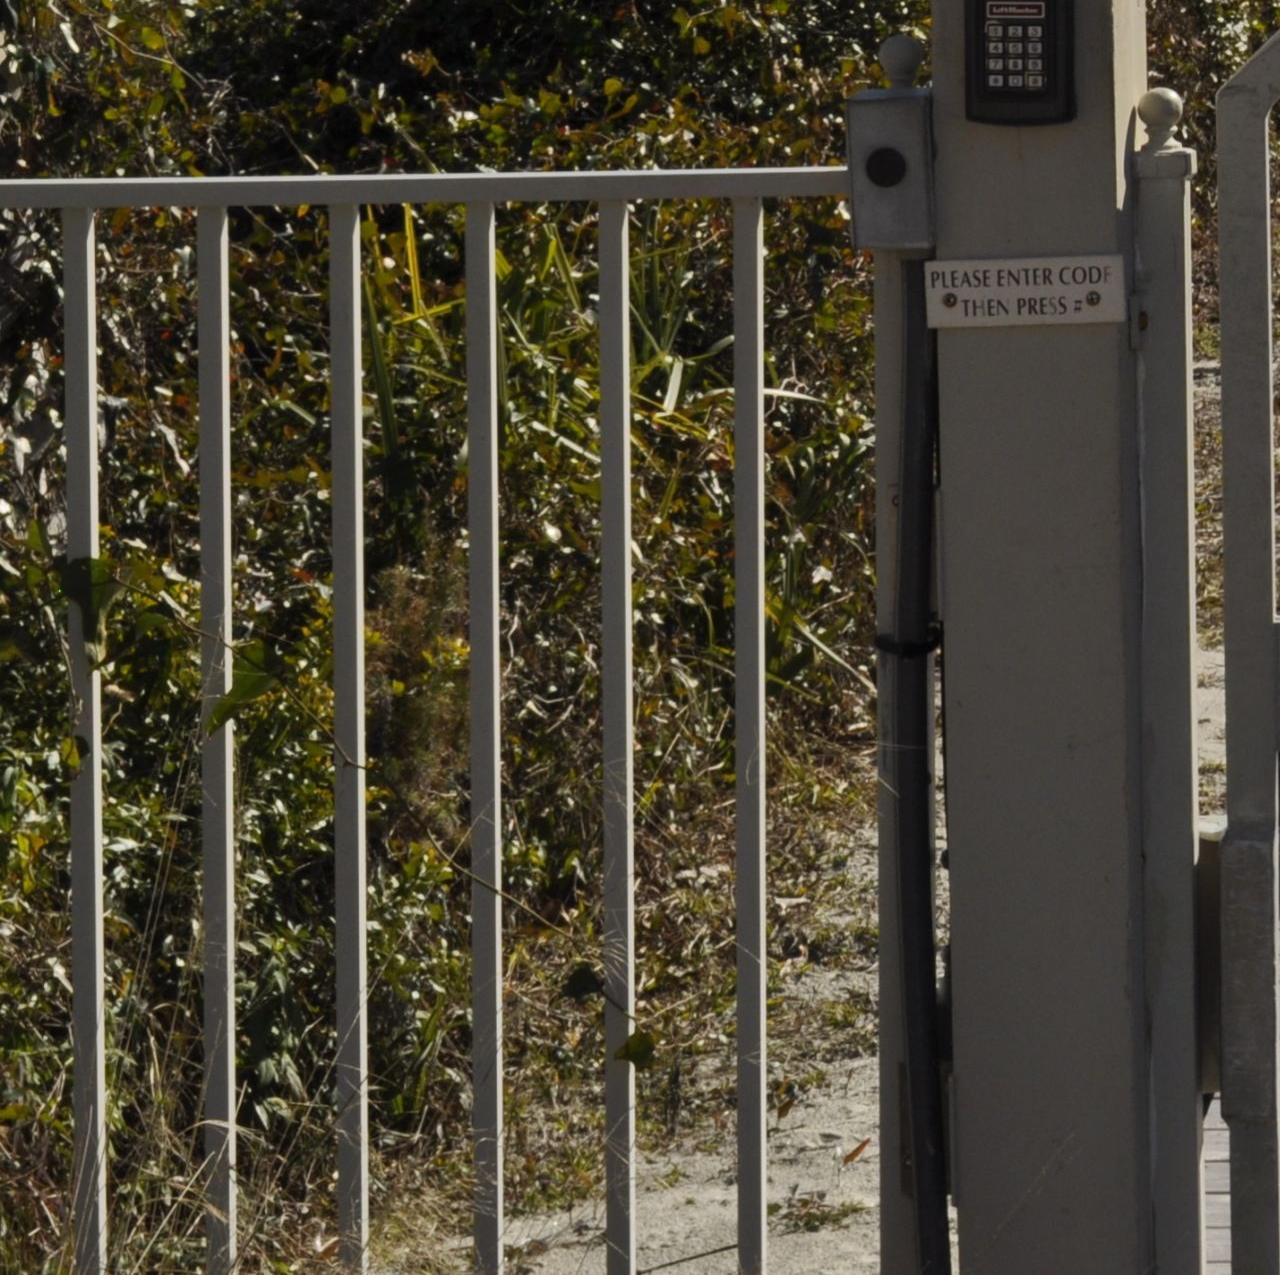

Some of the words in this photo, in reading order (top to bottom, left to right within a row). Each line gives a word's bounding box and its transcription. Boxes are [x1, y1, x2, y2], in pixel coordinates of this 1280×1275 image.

[930, 269, 990, 289] PLEASE
[997, 267, 1053, 288] ENTER
[961, 297, 1010, 317] THEN
[1017, 296, 1068, 316] PRESS
